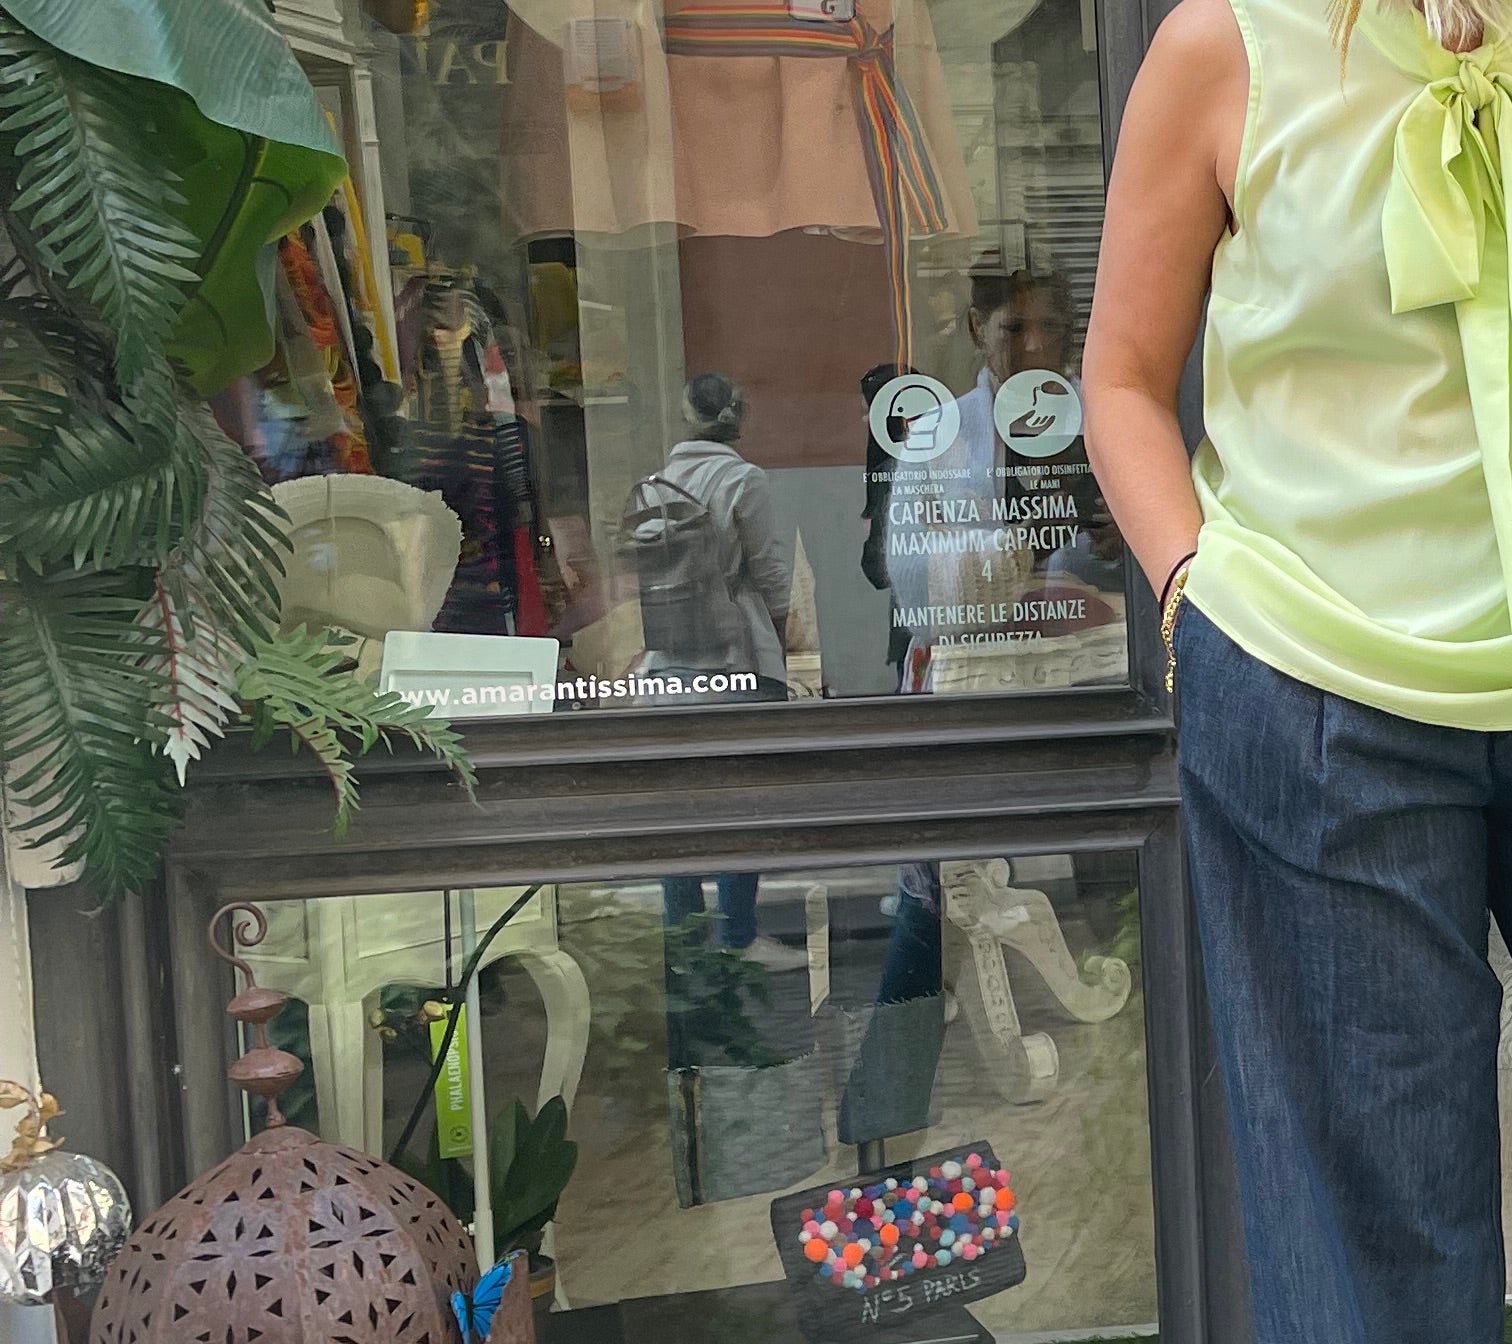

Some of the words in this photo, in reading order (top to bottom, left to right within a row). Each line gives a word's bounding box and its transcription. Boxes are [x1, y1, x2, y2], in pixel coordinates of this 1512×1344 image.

[871, 469, 928, 483] OBBLIGATORIO
[928, 467, 972, 481] INDOSSARE
[995, 466, 1051, 478] OBBLIGATORIO
[903, 483, 945, 496] MASCHERA
[1029, 479, 1040, 491] LE
[889, 499, 981, 526] CAPIENZA
[992, 495, 1079, 522] MASSIMA
[891, 529, 985, 557] MAXIMUM
[993, 525, 1079, 552] CAPACITY
[981, 559, 993, 583] 4
[892, 603, 985, 628] MANTENERE
[991, 602, 1008, 623] LE
[1013, 598, 1087, 622] DISTANZE
[373, 670, 758, 707] ww.amarantissima.com
